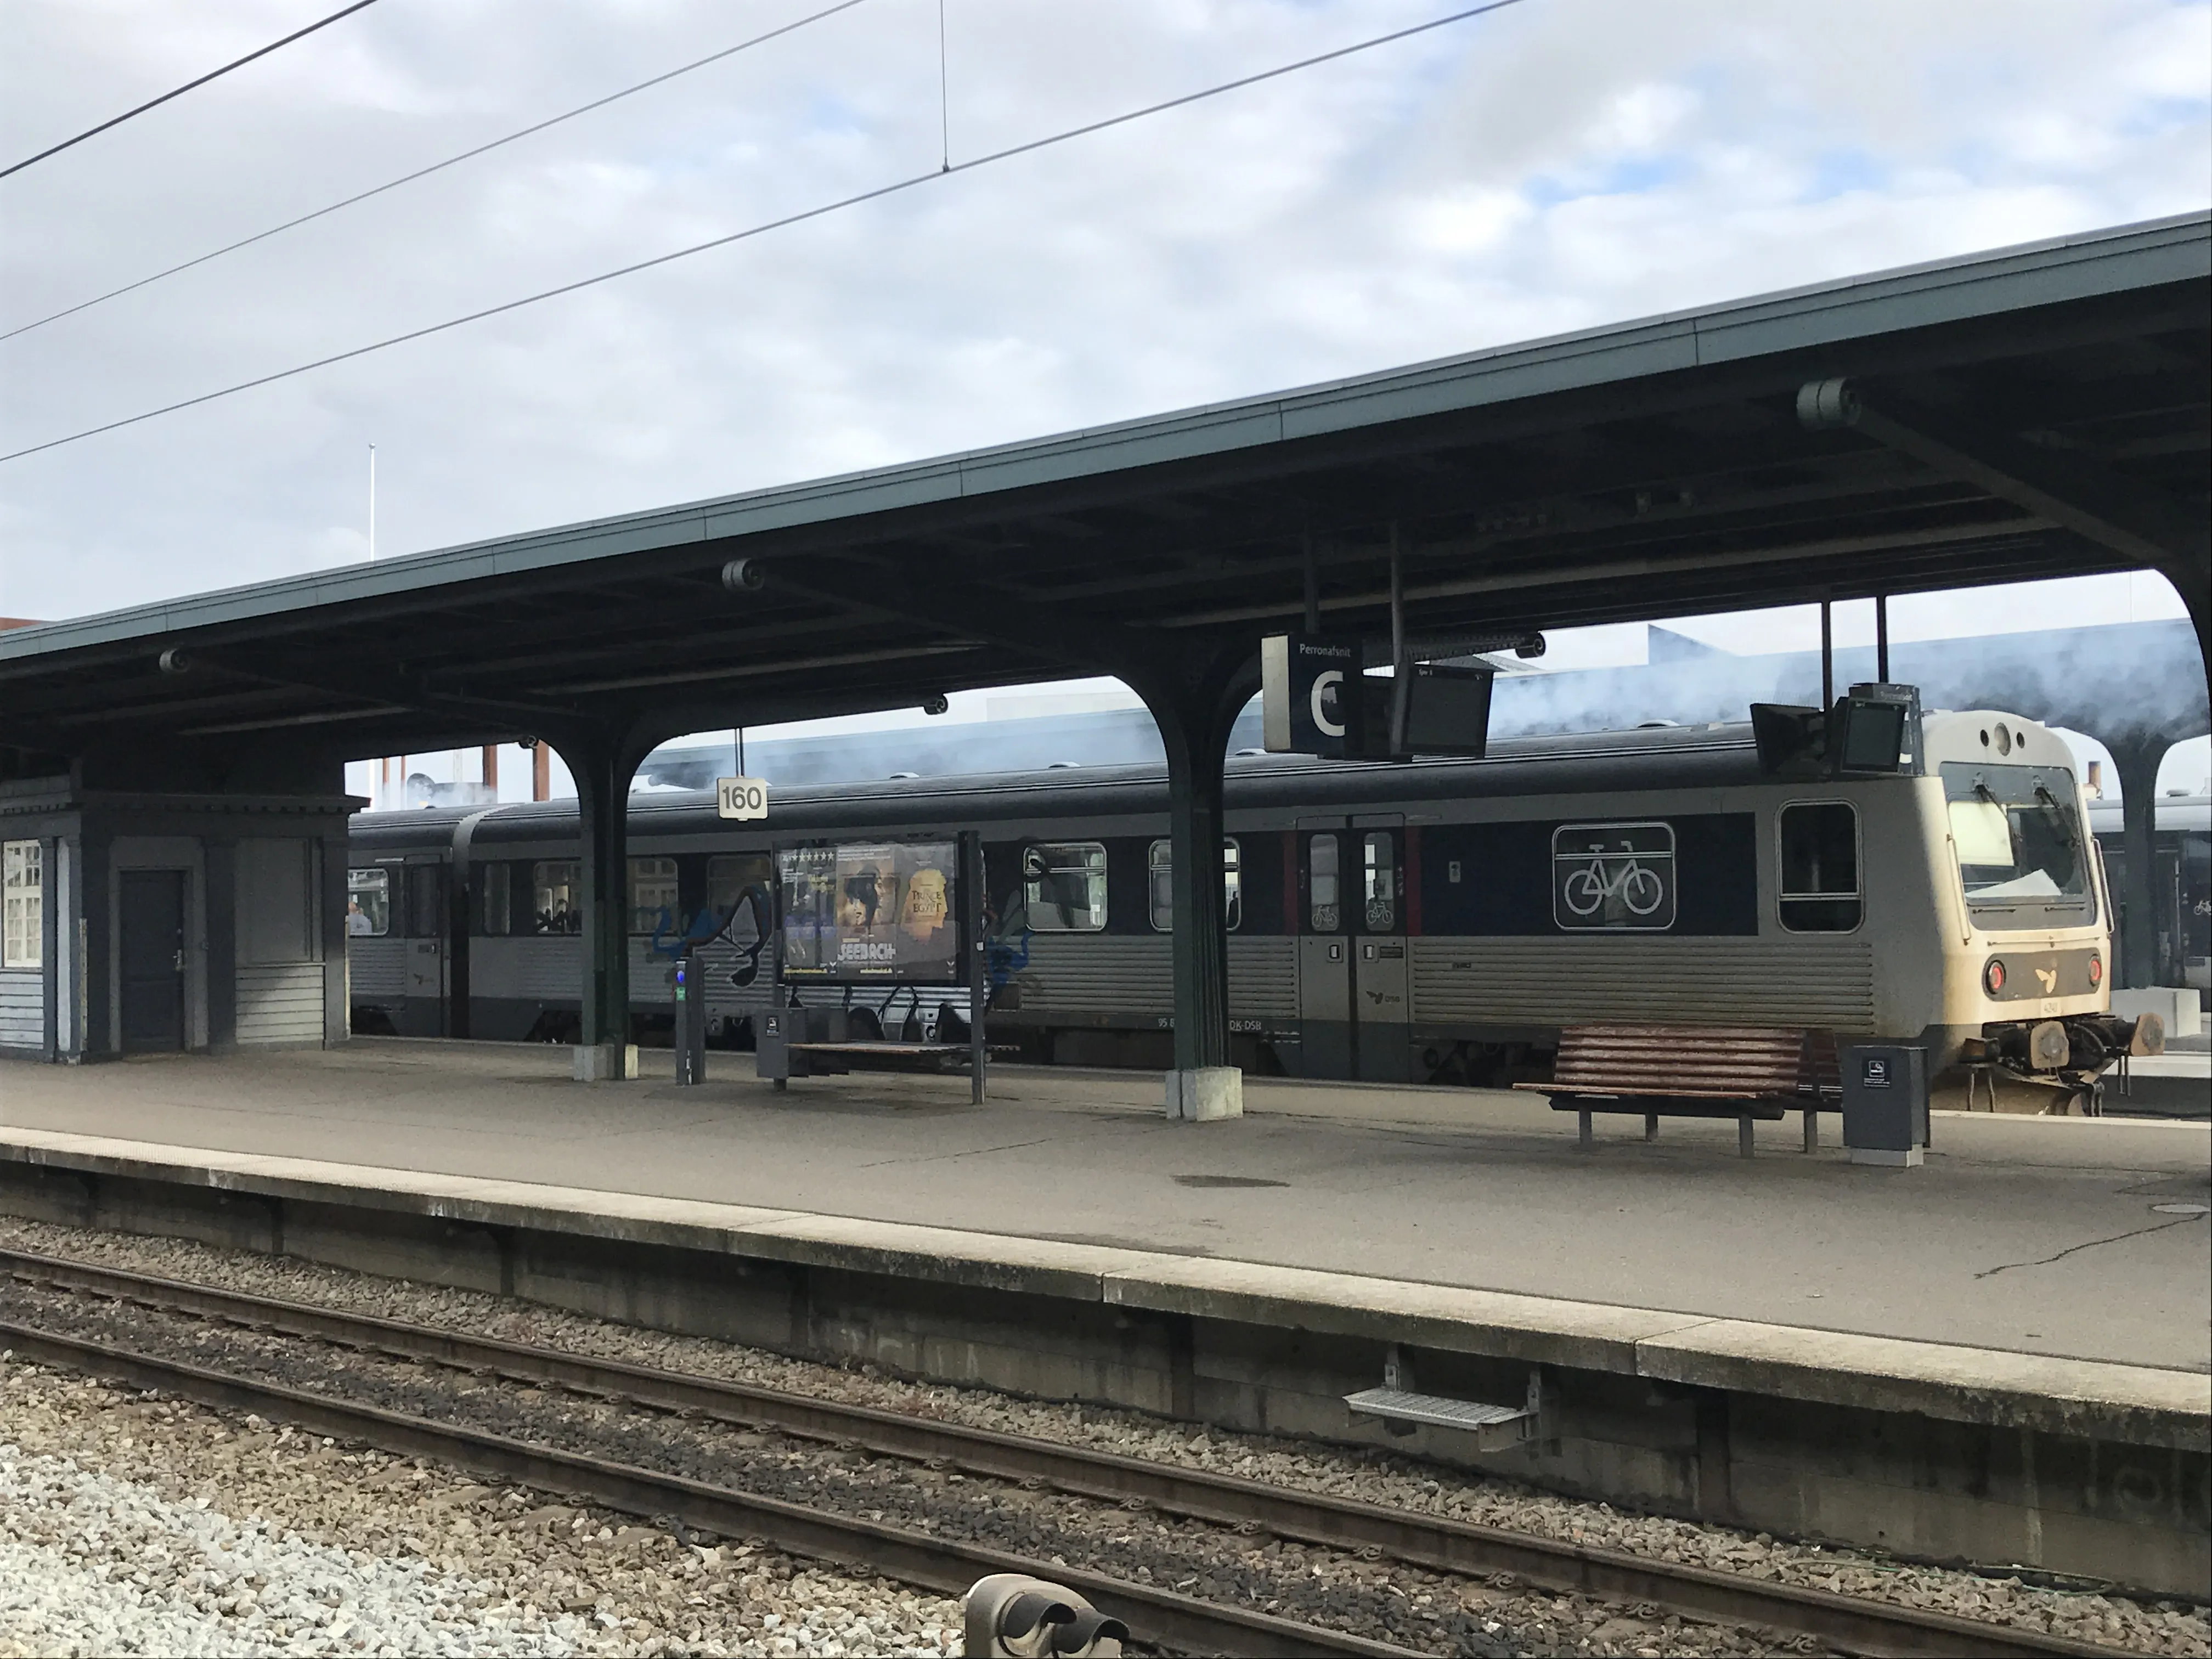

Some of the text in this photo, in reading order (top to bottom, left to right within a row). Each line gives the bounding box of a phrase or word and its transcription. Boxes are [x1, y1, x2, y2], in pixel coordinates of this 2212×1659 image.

[1299, 643, 1351, 658] Perronafsnit
[1310, 670, 1346, 737] C
[722, 786, 762, 810] 160
[1158, 1018, 1168, 1028] 95
